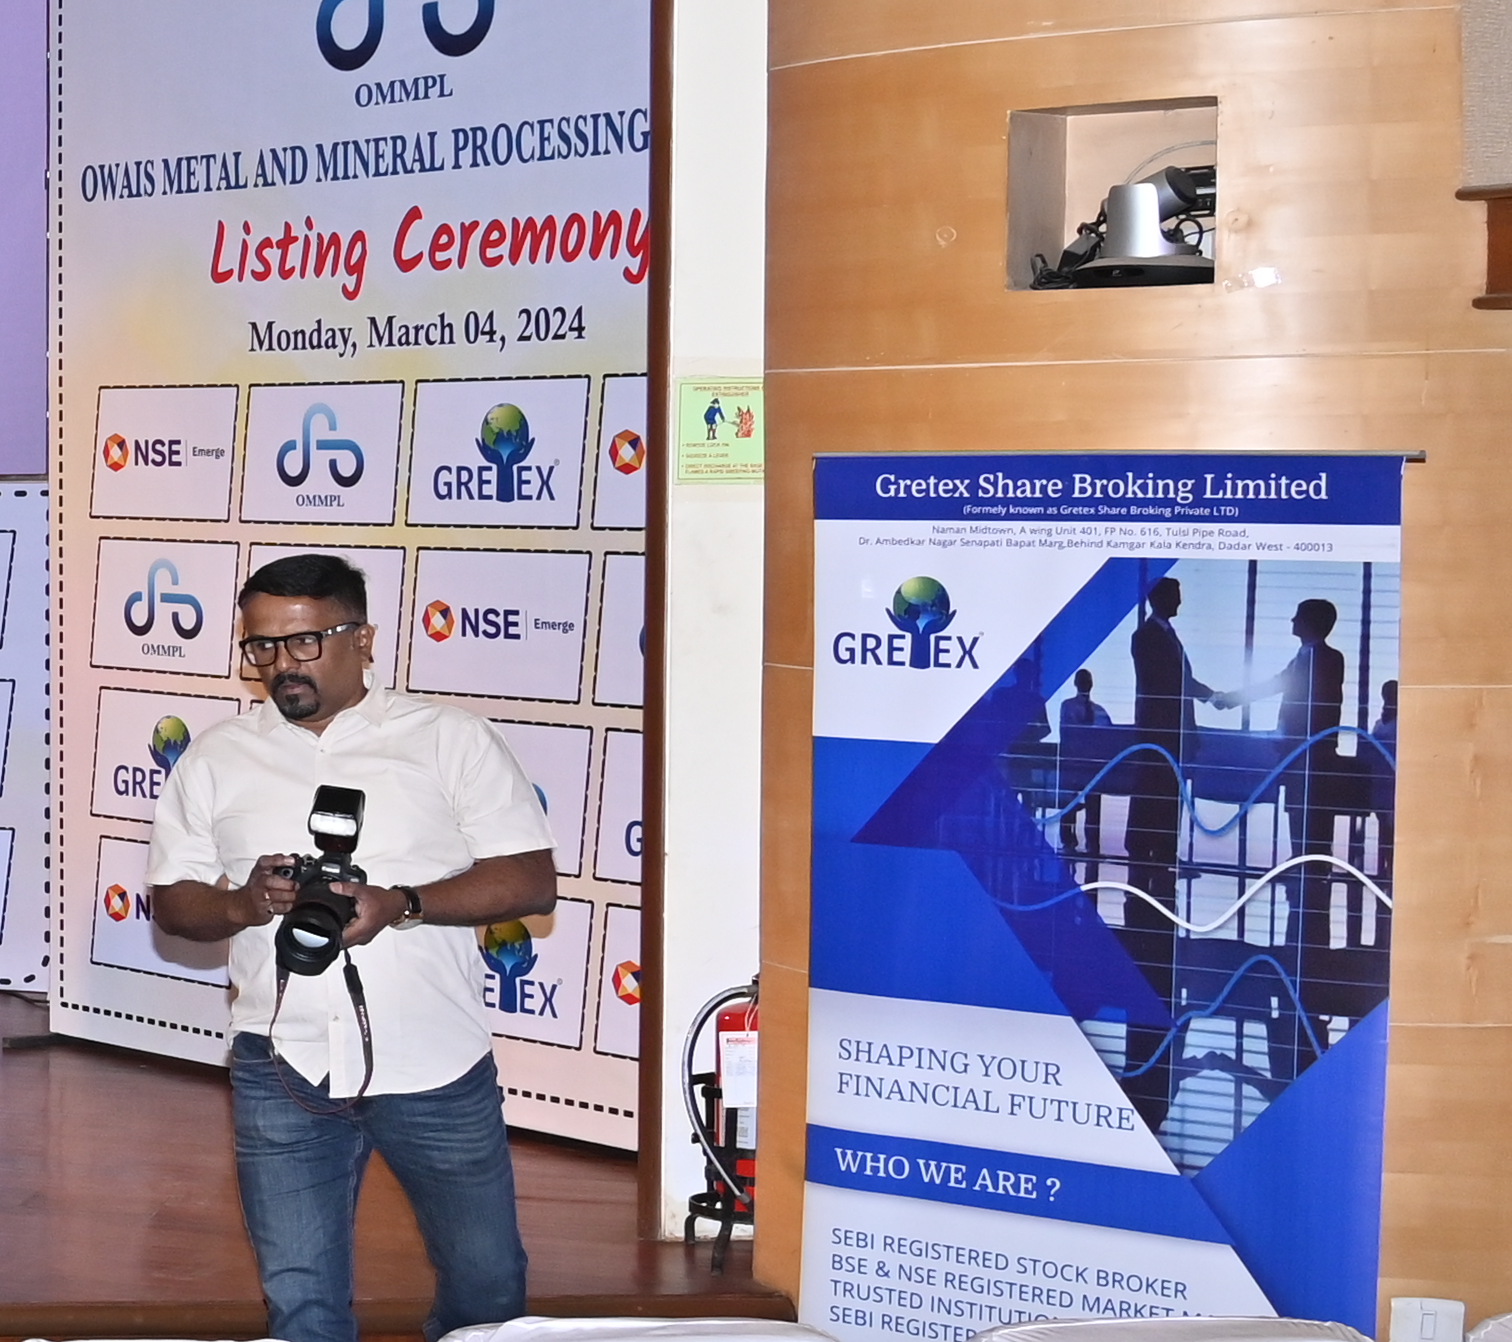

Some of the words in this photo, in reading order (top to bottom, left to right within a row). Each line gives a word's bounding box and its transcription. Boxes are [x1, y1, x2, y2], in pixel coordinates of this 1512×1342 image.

[354, 73, 453, 109] OMMPL
[81, 156, 157, 202] OWAIS
[162, 149, 249, 197] METAL
[253, 144, 308, 187] AND
[316, 132, 445, 184] MINERAL
[451, 107, 651, 170] PROCESSING
[210, 215, 367, 301] Listing
[393, 204, 651, 285] Ceremony
[248, 318, 358, 358] Monday,
[366, 311, 455, 348] March
[464, 311, 507, 354] 04,
[517, 306, 586, 343] 2024
[134, 439, 182, 467] NSE
[192, 445, 225, 460] Emerge
[295, 494, 345, 508] OMMPL
[432, 464, 557, 503] GRETEX
[875, 473, 970, 498] Gretex
[978, 472, 1063, 498] Share
[1072, 472, 1195, 504] Broking
[1203, 473, 1328, 500] Limited
[1009, 505, 1044, 515] known
[1047, 507, 1057, 515] as
[1060, 505, 1095, 515] Gretex
[1098, 505, 1127, 515] Share
[1130, 505, 1171, 517] Broking
[1174, 506, 1210, 516] Private
[1213, 506, 1239, 517] LTD)
[875, 537, 925, 546] Ambedkar
[928, 537, 957, 548] Nagar
[960, 537, 1002, 549] Senapati
[1006, 538, 1036, 549] Bapat
[1106, 539, 1145, 551] Kamgar
[1218, 541, 1252, 551] Dadar
[1255, 542, 1283, 552] West
[1293, 543, 1333, 553] 400013
[1029, 526, 1052, 536] wing
[1055, 526, 1076, 535] Unit
[1105, 527, 1116, 536] FP
[1192, 527, 1214, 539] Pipe
[460, 607, 521, 641] NSE
[533, 617, 576, 634] Emerge
[141, 643, 186, 658] OMMPL
[833, 631, 980, 671] GRETEX
[837, 1038, 970, 1076] SHAPING
[978, 1052, 1063, 1087] YOUR
[836, 1072, 1000, 1113] FINANCIAL
[1007, 1093, 1136, 1132] FUTURE
[834, 1147, 910, 1181] WHO
[917, 1158, 967, 1189] WE
[973, 1166, 1038, 1200] ARE
[831, 1227, 875, 1250] SEBI
[883, 1234, 1009, 1271] REGISTERED
[1016, 1256, 1089, 1285] STOCK
[1096, 1269, 1188, 1300] BROKER
[831, 1254, 868, 1275] BSE
[875, 1260, 891, 1278] &
[898, 1263, 937, 1286] NSE
[944, 1271, 1073, 1308] REGISTERED
[830, 1279, 923, 1310] TRUSTED
[829, 1305, 873, 1328] SEBI
[881, 1313, 977, 1342] REGISTER
